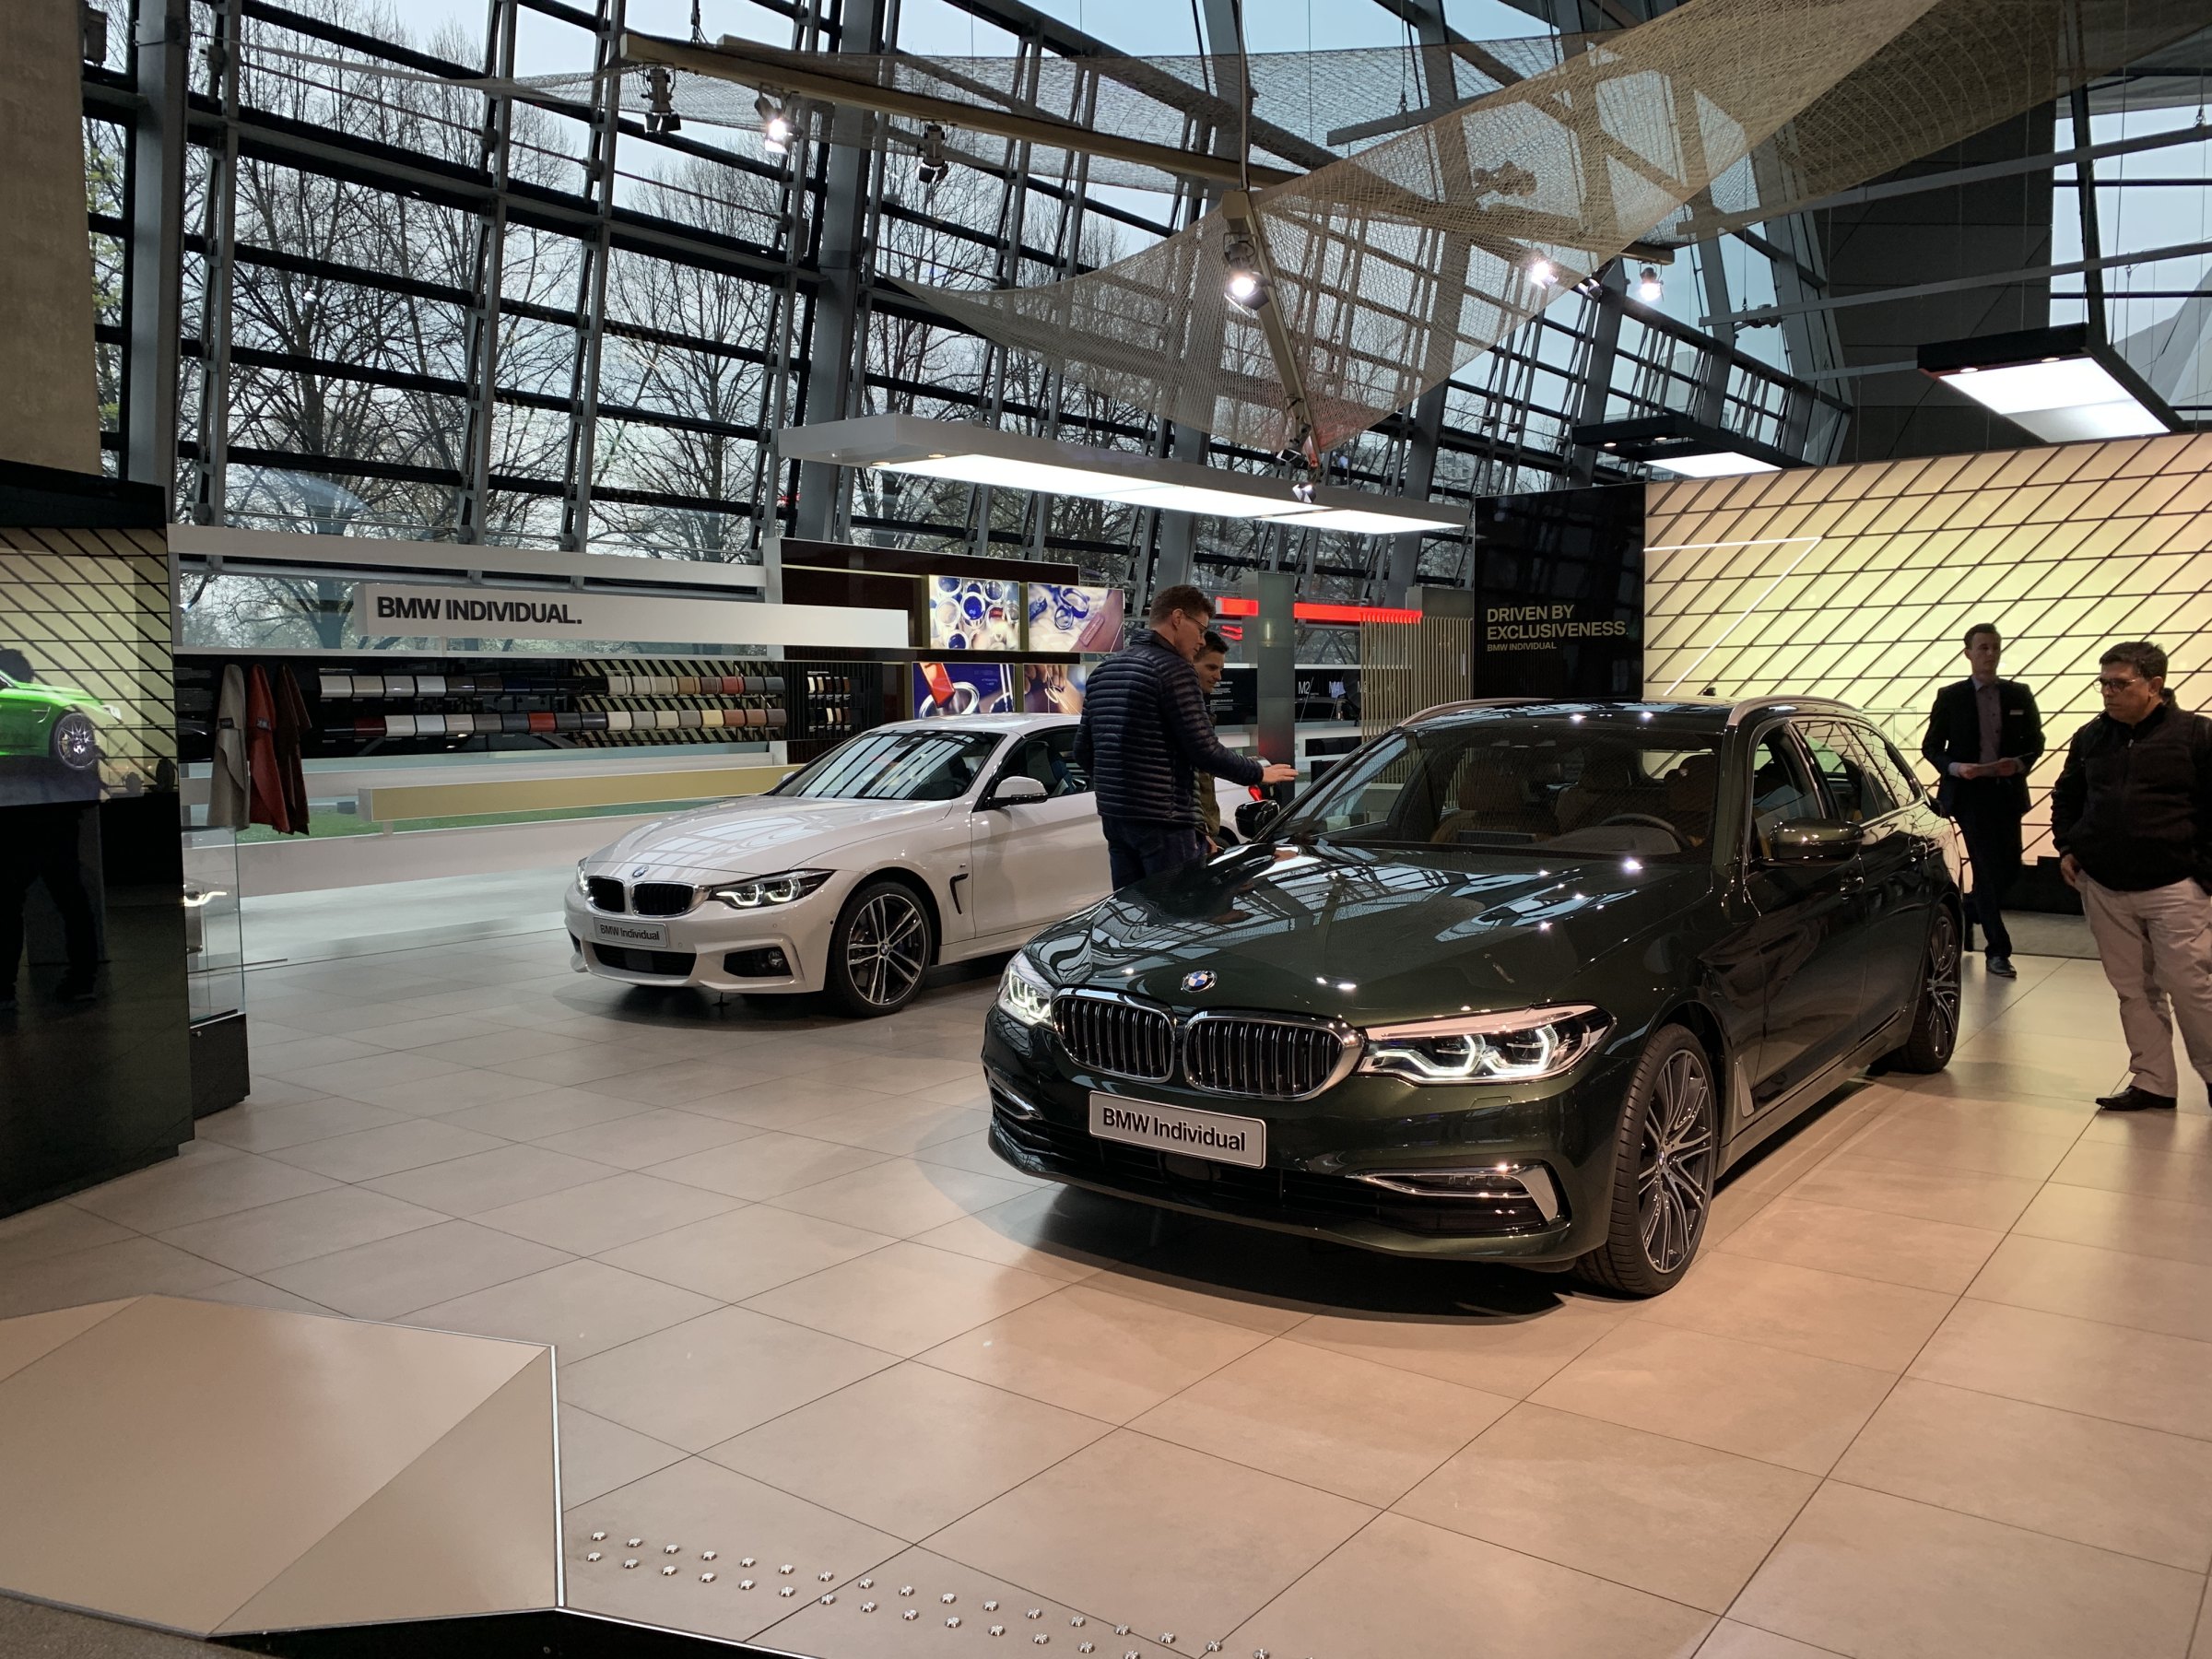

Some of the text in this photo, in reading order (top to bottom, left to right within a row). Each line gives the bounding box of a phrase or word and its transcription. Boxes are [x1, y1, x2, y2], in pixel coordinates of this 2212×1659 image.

[377, 596, 582, 625] BMW INDIVIDUAL.
[1487, 604, 1575, 622] DRIVEN BY
[1487, 641, 1558, 653] BMW INDIVIDUAL
[600, 924, 660, 940] BMW Individual
[1103, 1107, 1246, 1152] BMW Individual
